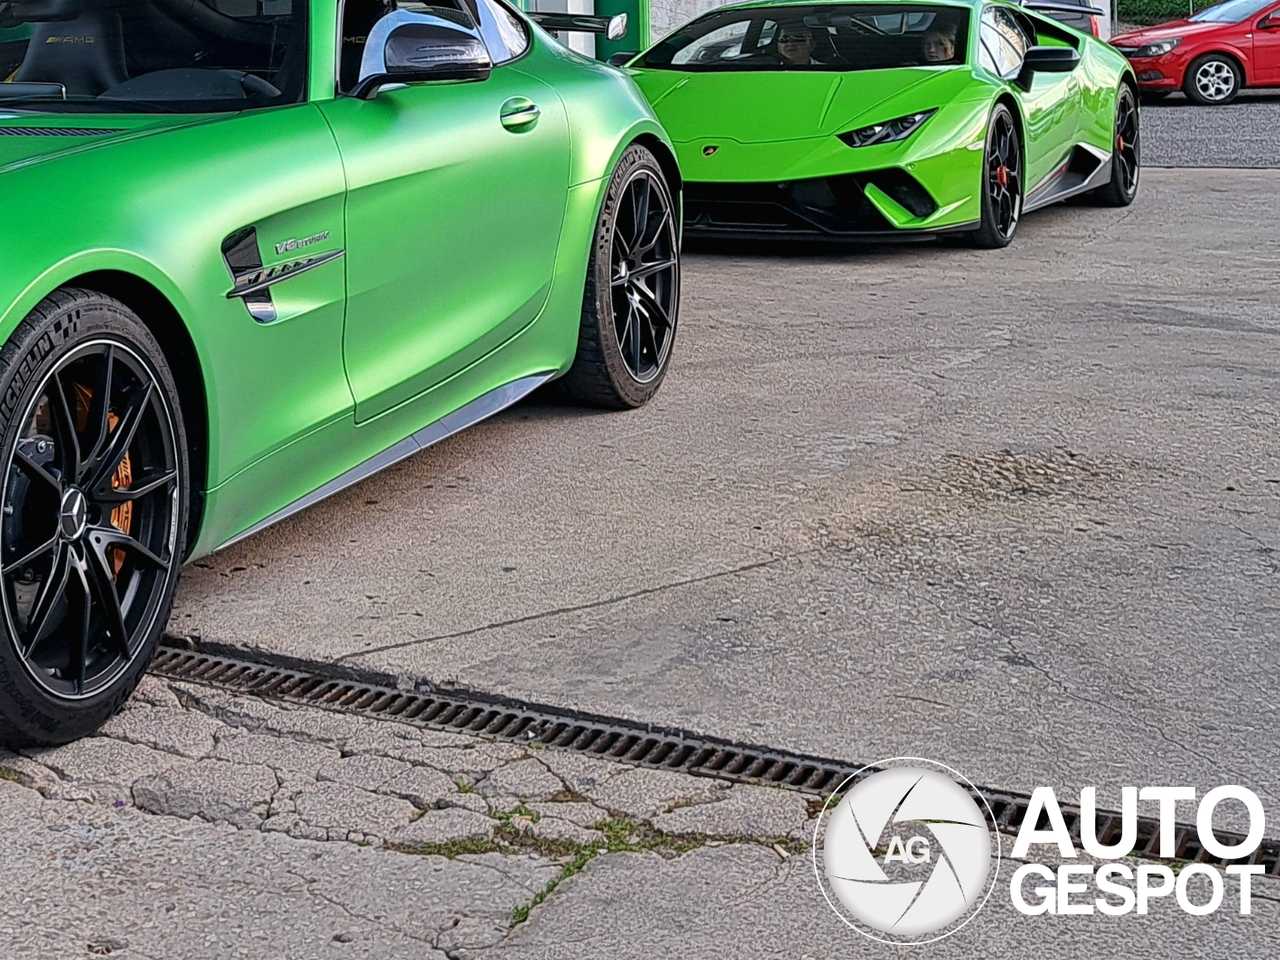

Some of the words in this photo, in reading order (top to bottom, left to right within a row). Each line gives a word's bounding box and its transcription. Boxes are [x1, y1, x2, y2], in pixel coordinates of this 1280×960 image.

[62, 36, 95, 44] AMG
[342, 36, 367, 44] MG
[609, 150, 635, 200] MICHELIN
[275, 238, 296, 255] V8
